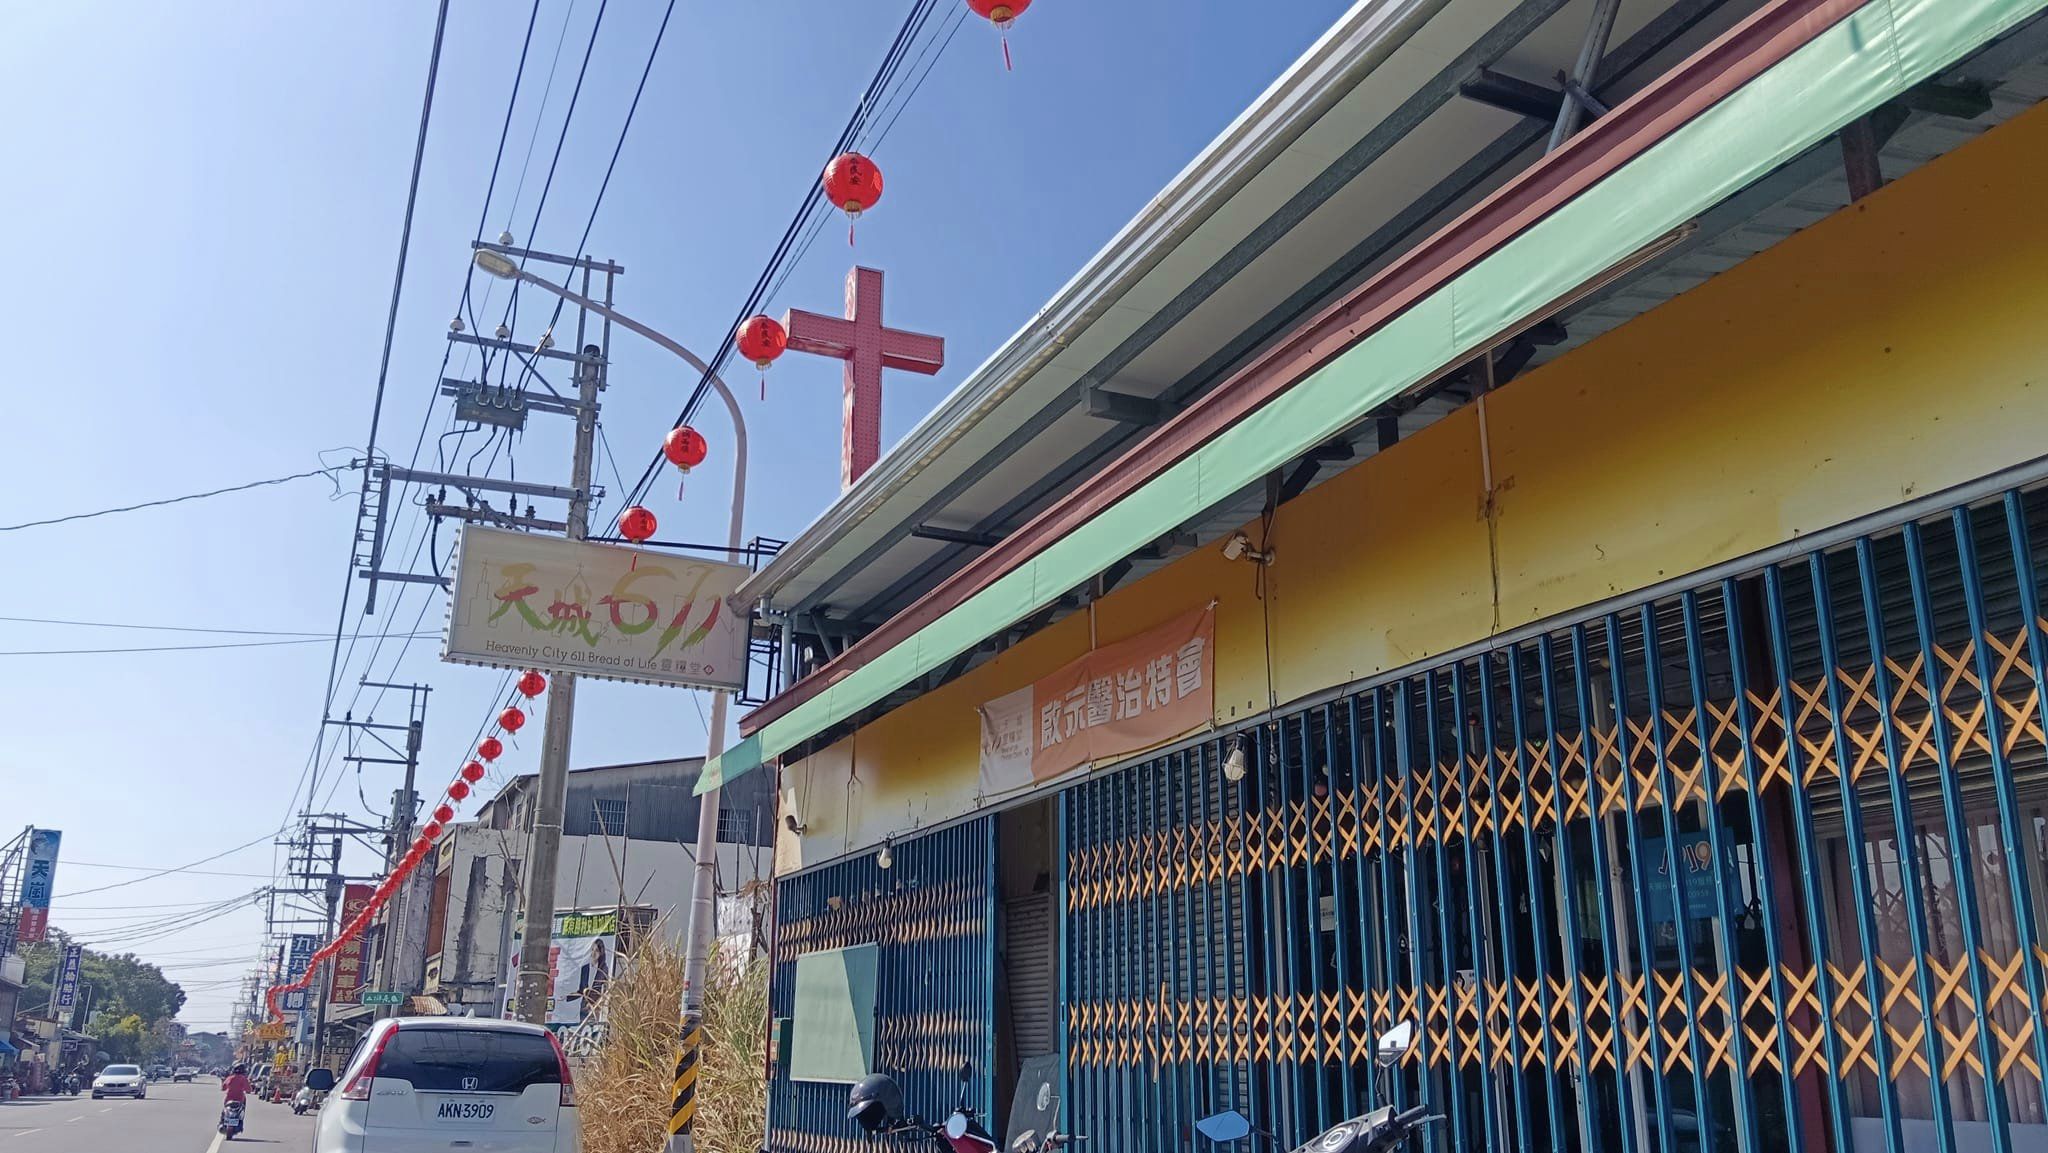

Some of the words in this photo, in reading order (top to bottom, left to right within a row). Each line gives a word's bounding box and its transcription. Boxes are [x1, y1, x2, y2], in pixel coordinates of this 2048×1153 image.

[486, 640, 539, 657] Heavenly
[542, 646, 568, 662] City
[571, 650, 585, 662] 611
[588, 649, 621, 666] Bread
[623, 653, 636, 667] of
[638, 655, 658, 671] Life
